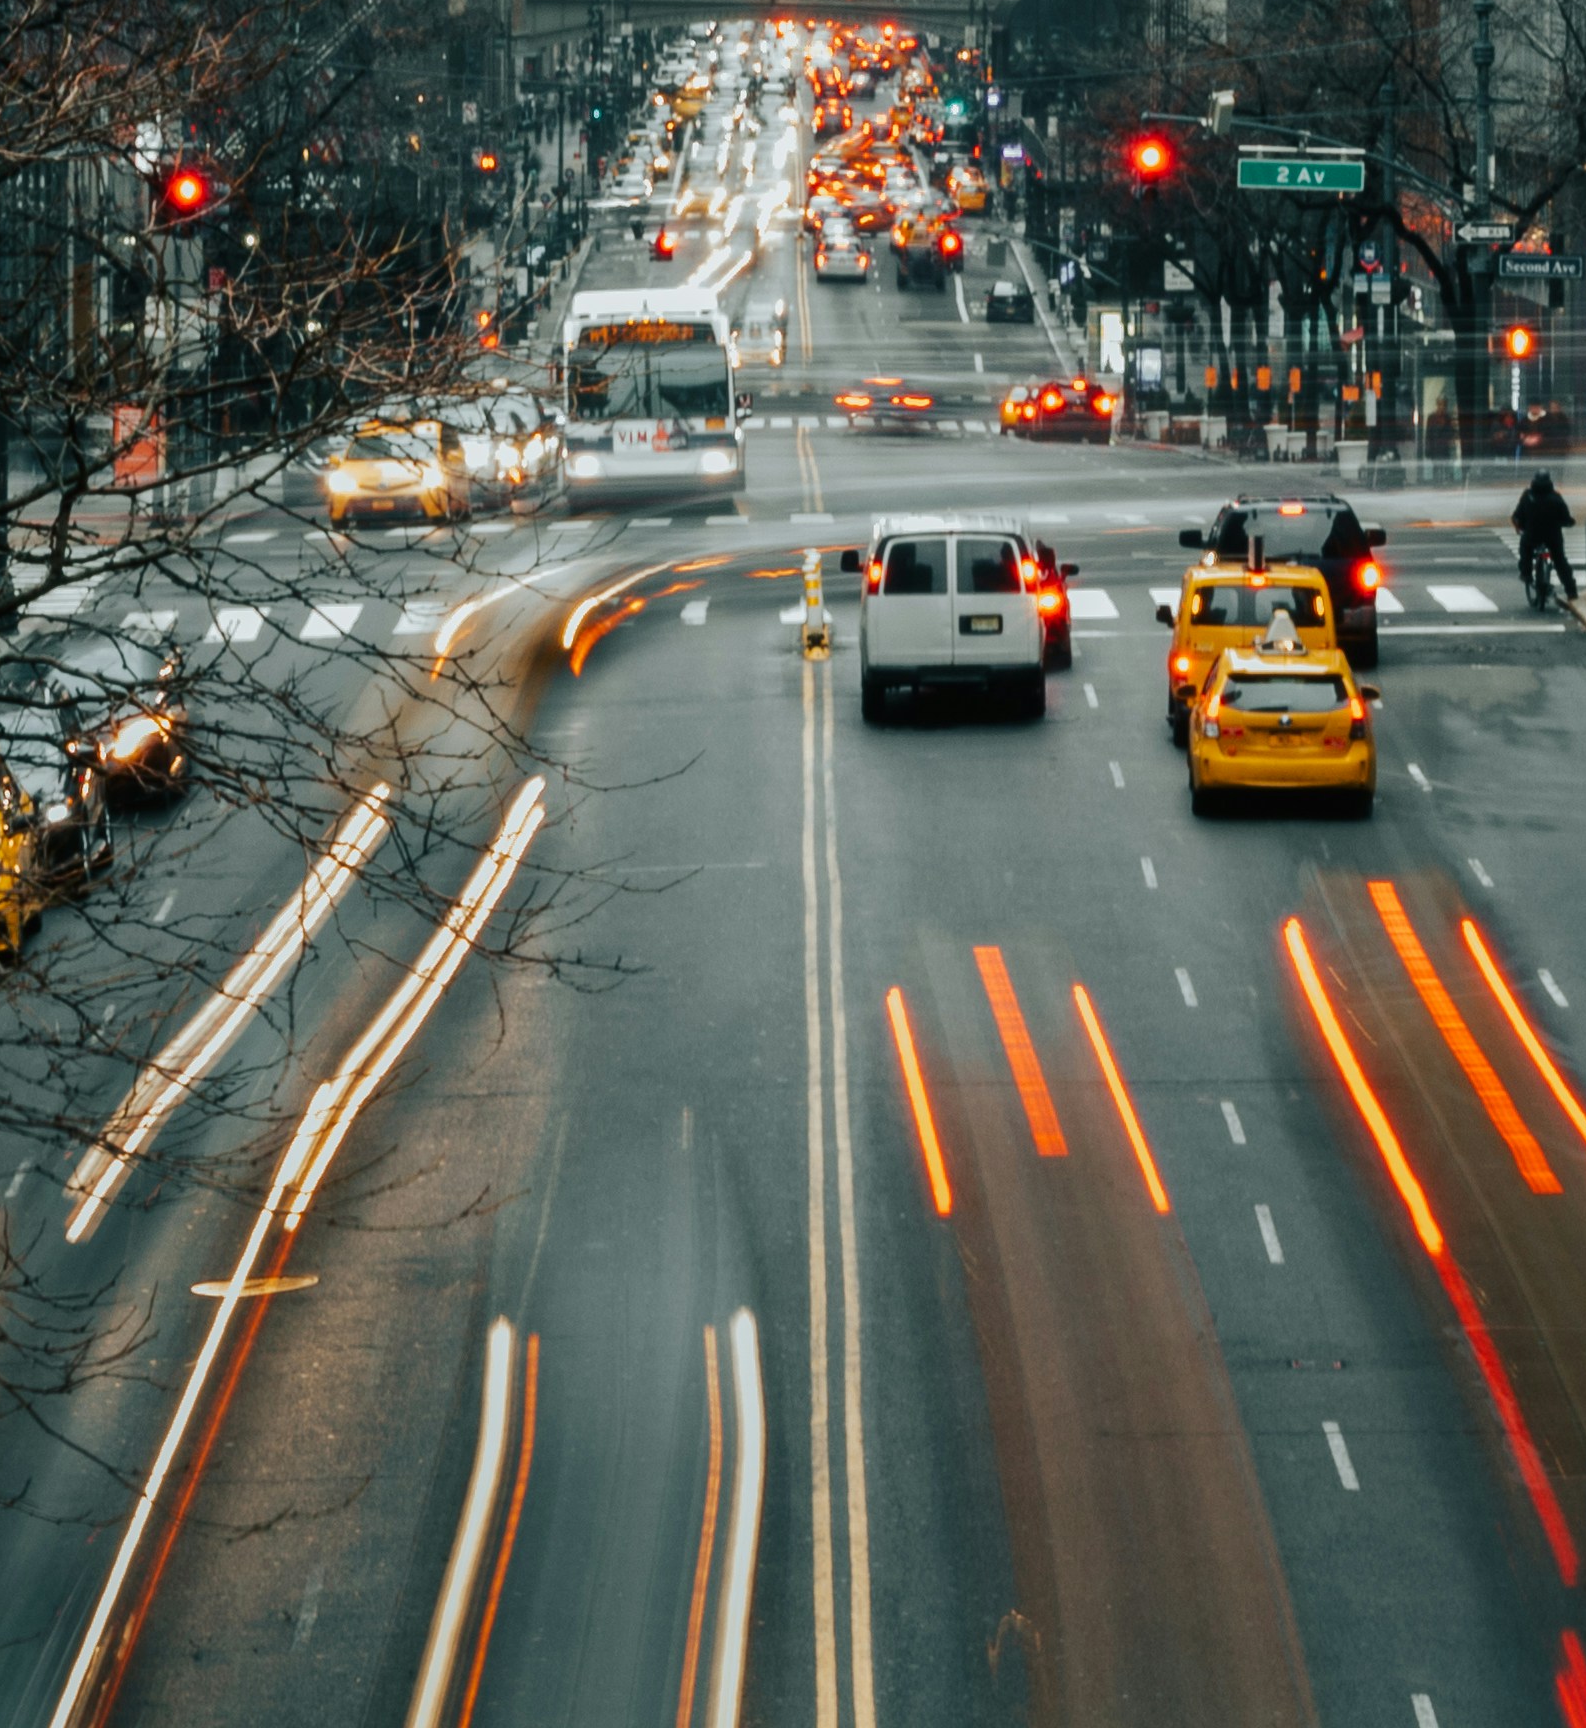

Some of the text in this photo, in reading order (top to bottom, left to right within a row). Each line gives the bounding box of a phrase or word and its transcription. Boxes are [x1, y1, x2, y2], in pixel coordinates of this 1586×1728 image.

[1276, 165, 1326, 185] 2 Av
[1505, 259, 1577, 275] Second Ave
